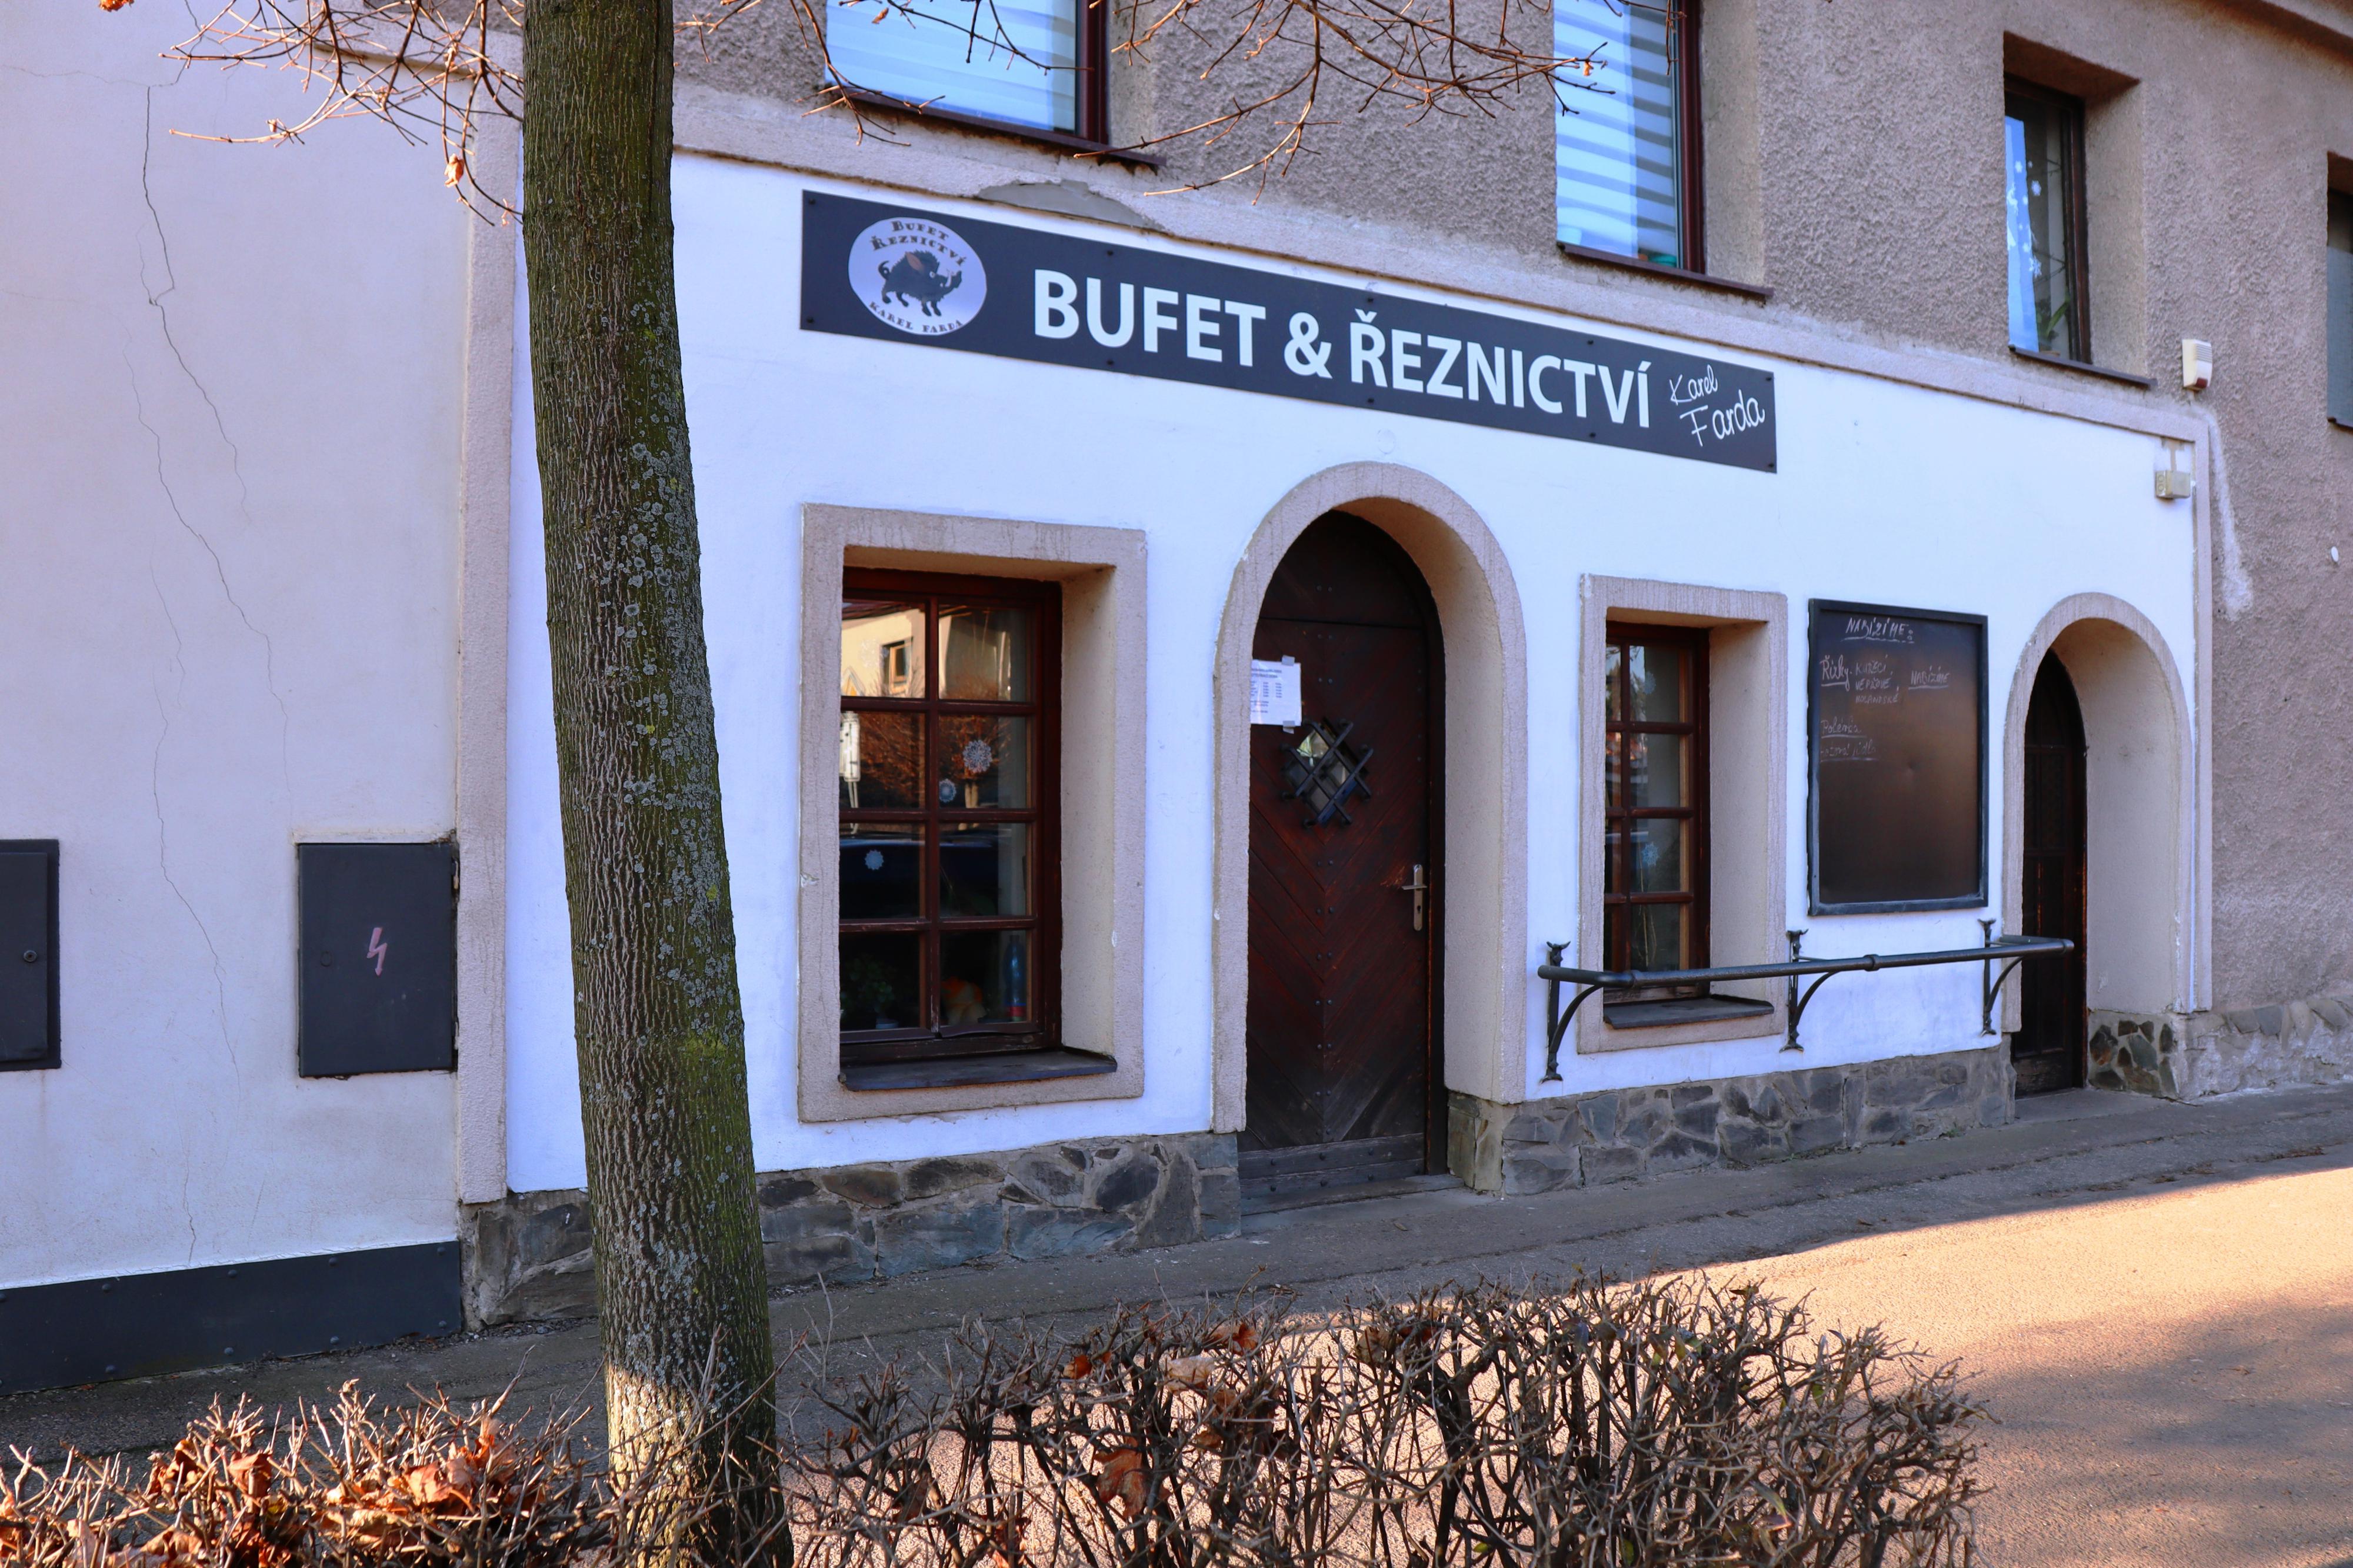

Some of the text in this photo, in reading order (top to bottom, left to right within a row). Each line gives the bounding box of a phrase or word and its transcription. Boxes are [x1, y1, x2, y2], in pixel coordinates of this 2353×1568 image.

[891, 219, 949, 241] BUFET
[869, 235, 967, 267] ŘEZNICTVÍ
[868, 301, 964, 333] KAREL FARDA
[1034, 268, 1652, 428] BUFET & ŘEZNICTVÍ
[1669, 364, 1718, 406] Karel
[1679, 390, 1765, 447] Farda
